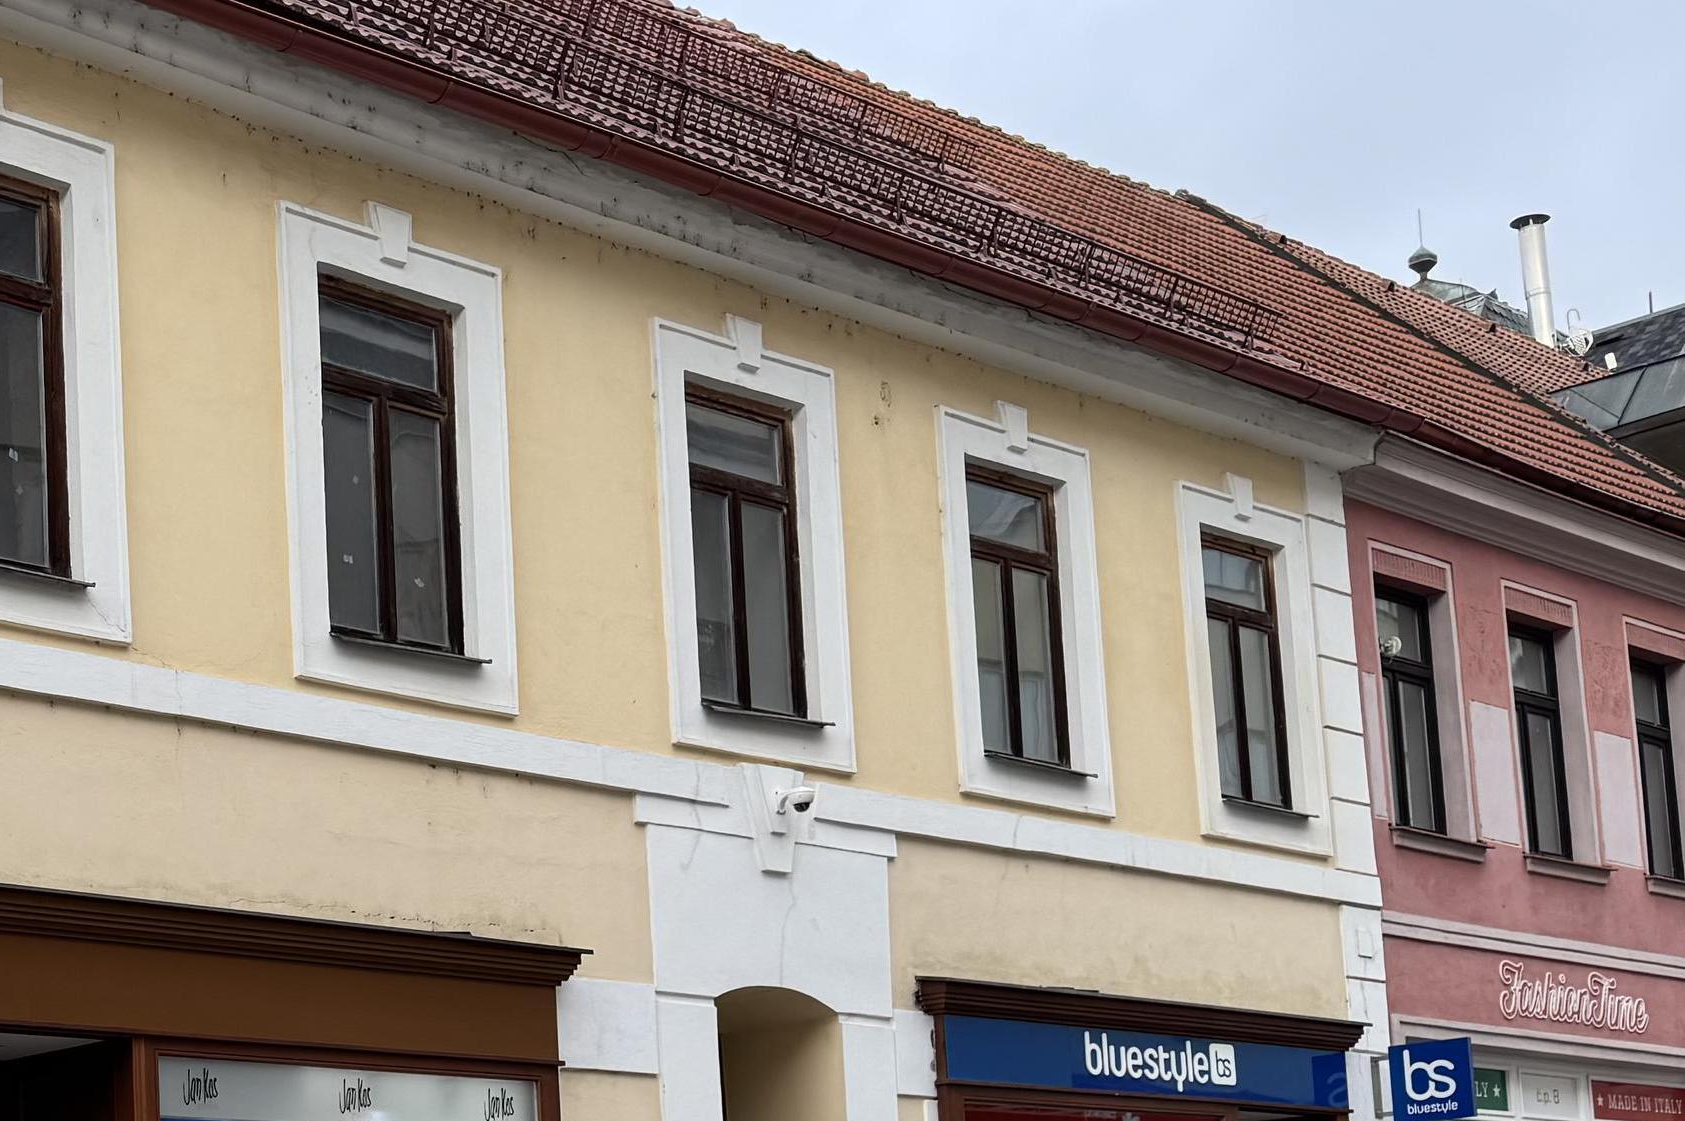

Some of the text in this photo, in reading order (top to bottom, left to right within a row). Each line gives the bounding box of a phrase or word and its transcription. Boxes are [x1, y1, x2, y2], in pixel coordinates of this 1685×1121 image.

[1083, 1030, 1209, 1093] bluestyle
[1402, 1049, 1457, 1101] bs
[183, 1067, 219, 1106] Jan Kos
[338, 1077, 372, 1114] Jan Kos
[483, 1087, 515, 1121] Jan Kos
[1552, 1088, 1560, 1105] 8
[1607, 1093, 1683, 1115] MADE IN ITALY
[1406, 1099, 1459, 1116] bluestyle
